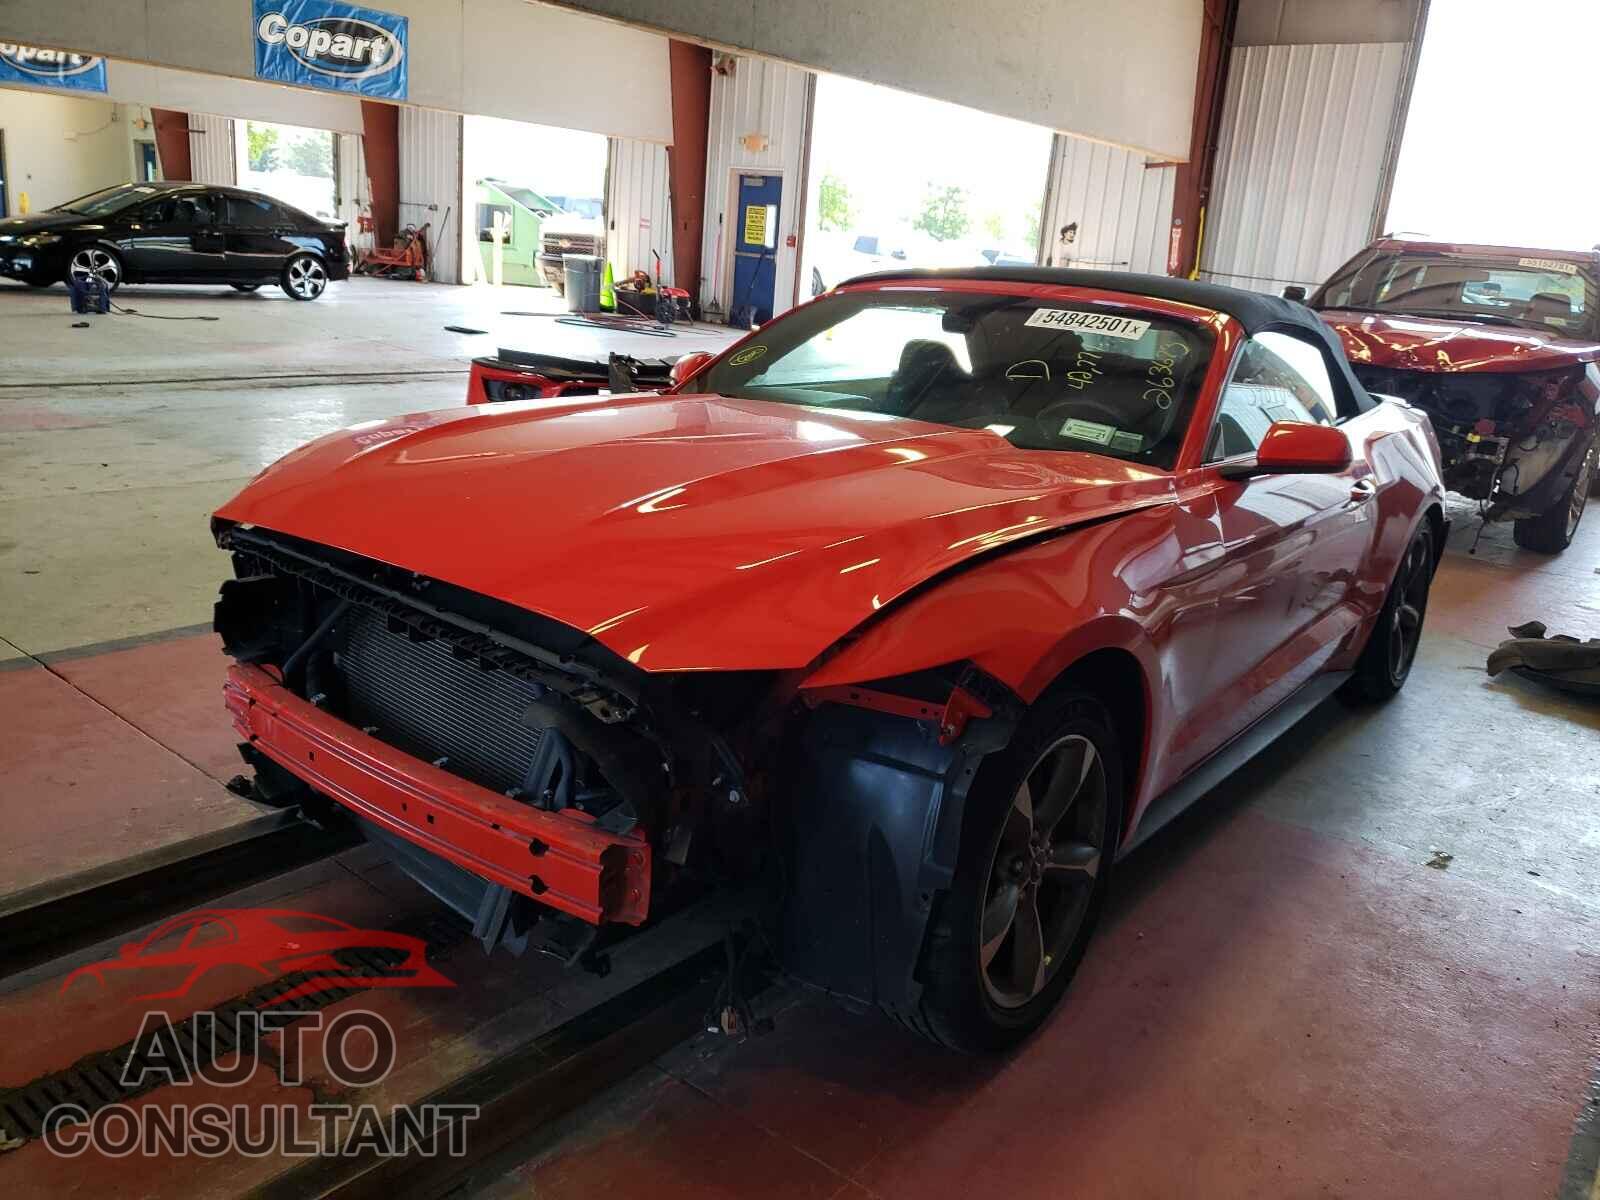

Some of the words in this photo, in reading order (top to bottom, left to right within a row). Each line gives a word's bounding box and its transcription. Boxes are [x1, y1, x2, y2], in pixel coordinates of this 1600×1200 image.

[257, 11, 387, 66] Copart
[0, 42, 82, 65] opart
[1043, 310, 1132, 333] 54842501
